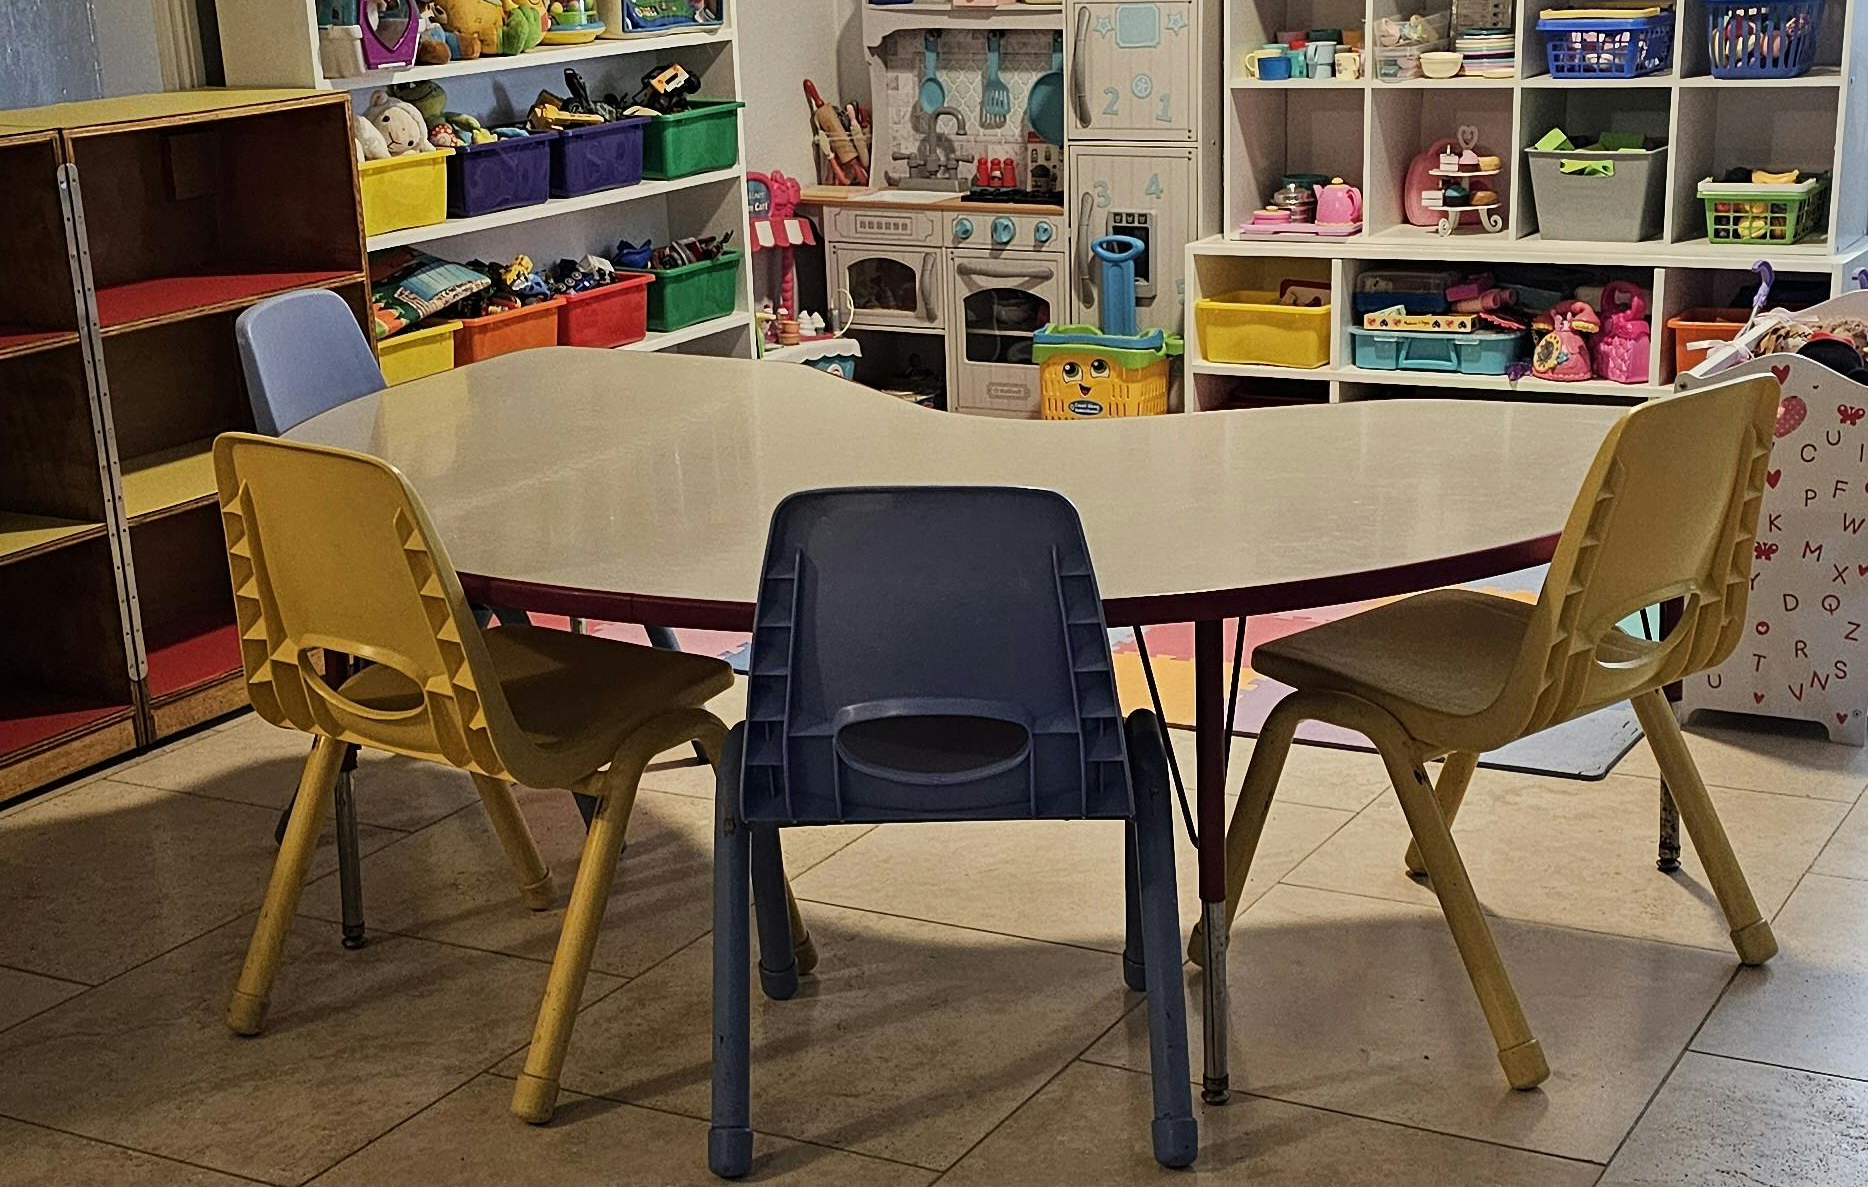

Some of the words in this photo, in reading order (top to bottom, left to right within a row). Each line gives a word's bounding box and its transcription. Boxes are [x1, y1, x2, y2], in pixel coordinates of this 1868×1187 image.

[1102, 86, 1119, 116] 2
[1155, 93, 1172, 123] 1
[1093, 180, 1111, 208] 3
[1144, 172, 1164, 199] 4
[1826, 430, 1841, 446] U
[1801, 443, 1817, 462] C
[1804, 488, 1817, 507] P
[1833, 480, 1848, 498] F
[1768, 513, 1782, 532] K
[1843, 512, 1866, 535] W
[1802, 540, 1823, 562] M
[1832, 564, 1849, 585] X
[1783, 593, 1799, 612] D
[1821, 594, 1841, 616] Q
[1844, 621, 1861, 641] Z
[1795, 640, 1808, 658] R
[1753, 653, 1767, 672] T
[1834, 660, 1848, 680] S
[1707, 673, 1722, 689] U
[1810, 670, 1830, 691] N
[1788, 683, 1804, 702] V
